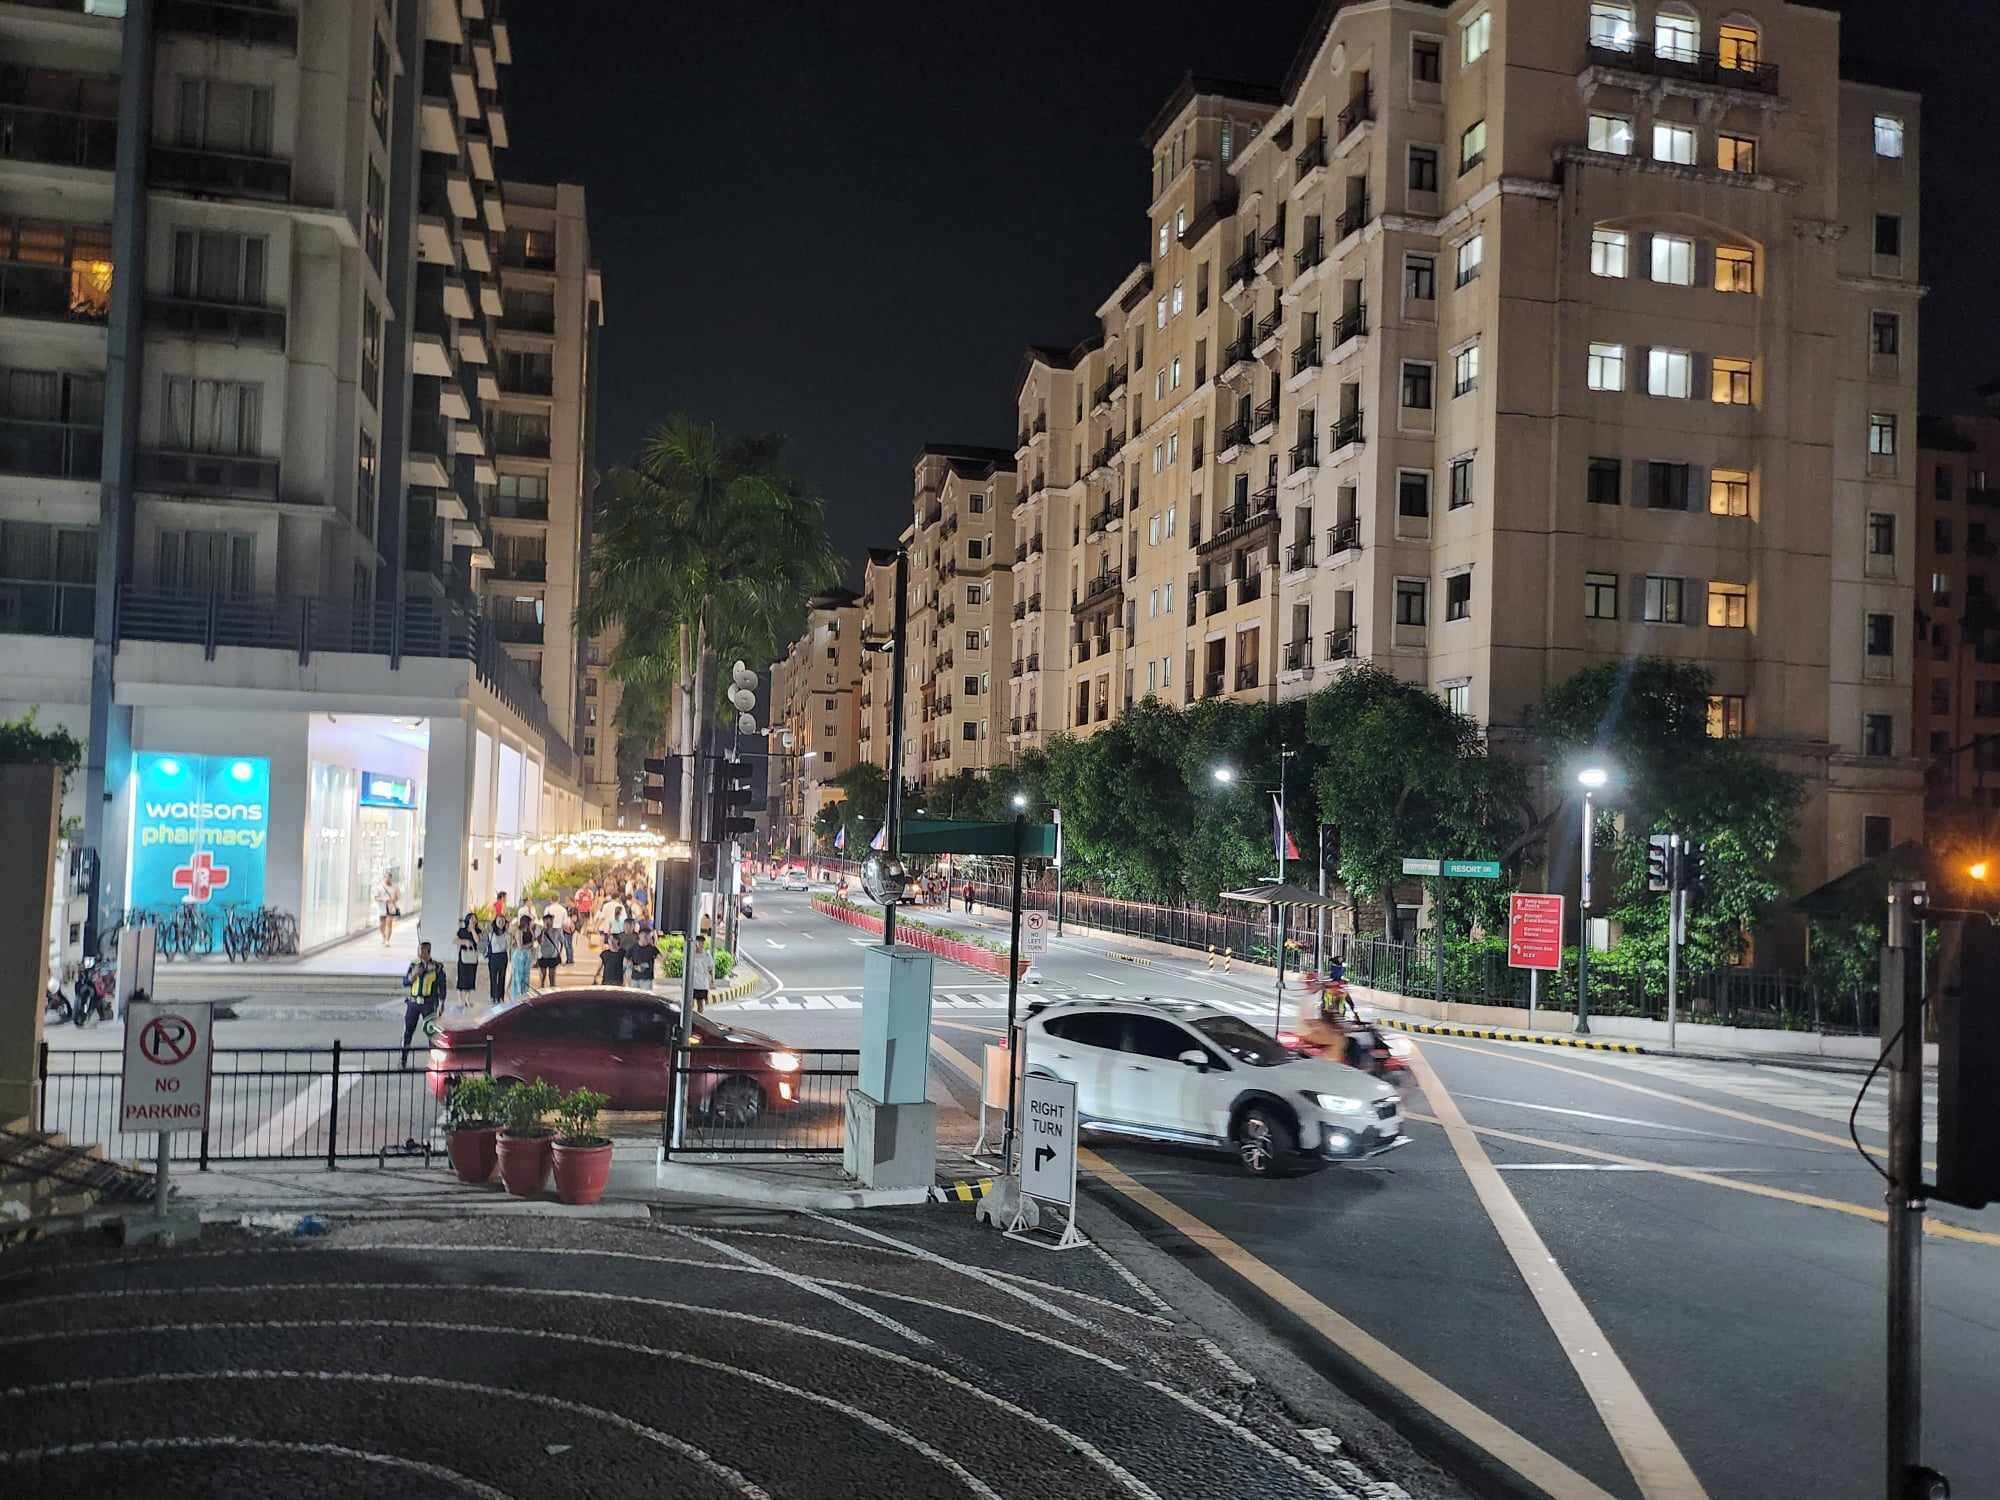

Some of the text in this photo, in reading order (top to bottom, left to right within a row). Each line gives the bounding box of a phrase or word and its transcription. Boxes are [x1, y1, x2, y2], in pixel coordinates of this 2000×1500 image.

[145, 802, 262, 820] watsons
[141, 824, 264, 848] pharmacy
[1450, 865, 1481, 873] RESORT
[155, 1078, 180, 1093] NO
[126, 1103, 201, 1119] PARKING
[1031, 1100, 1065, 1118] RIGHT
[1032, 1118, 1063, 1136] TURN
